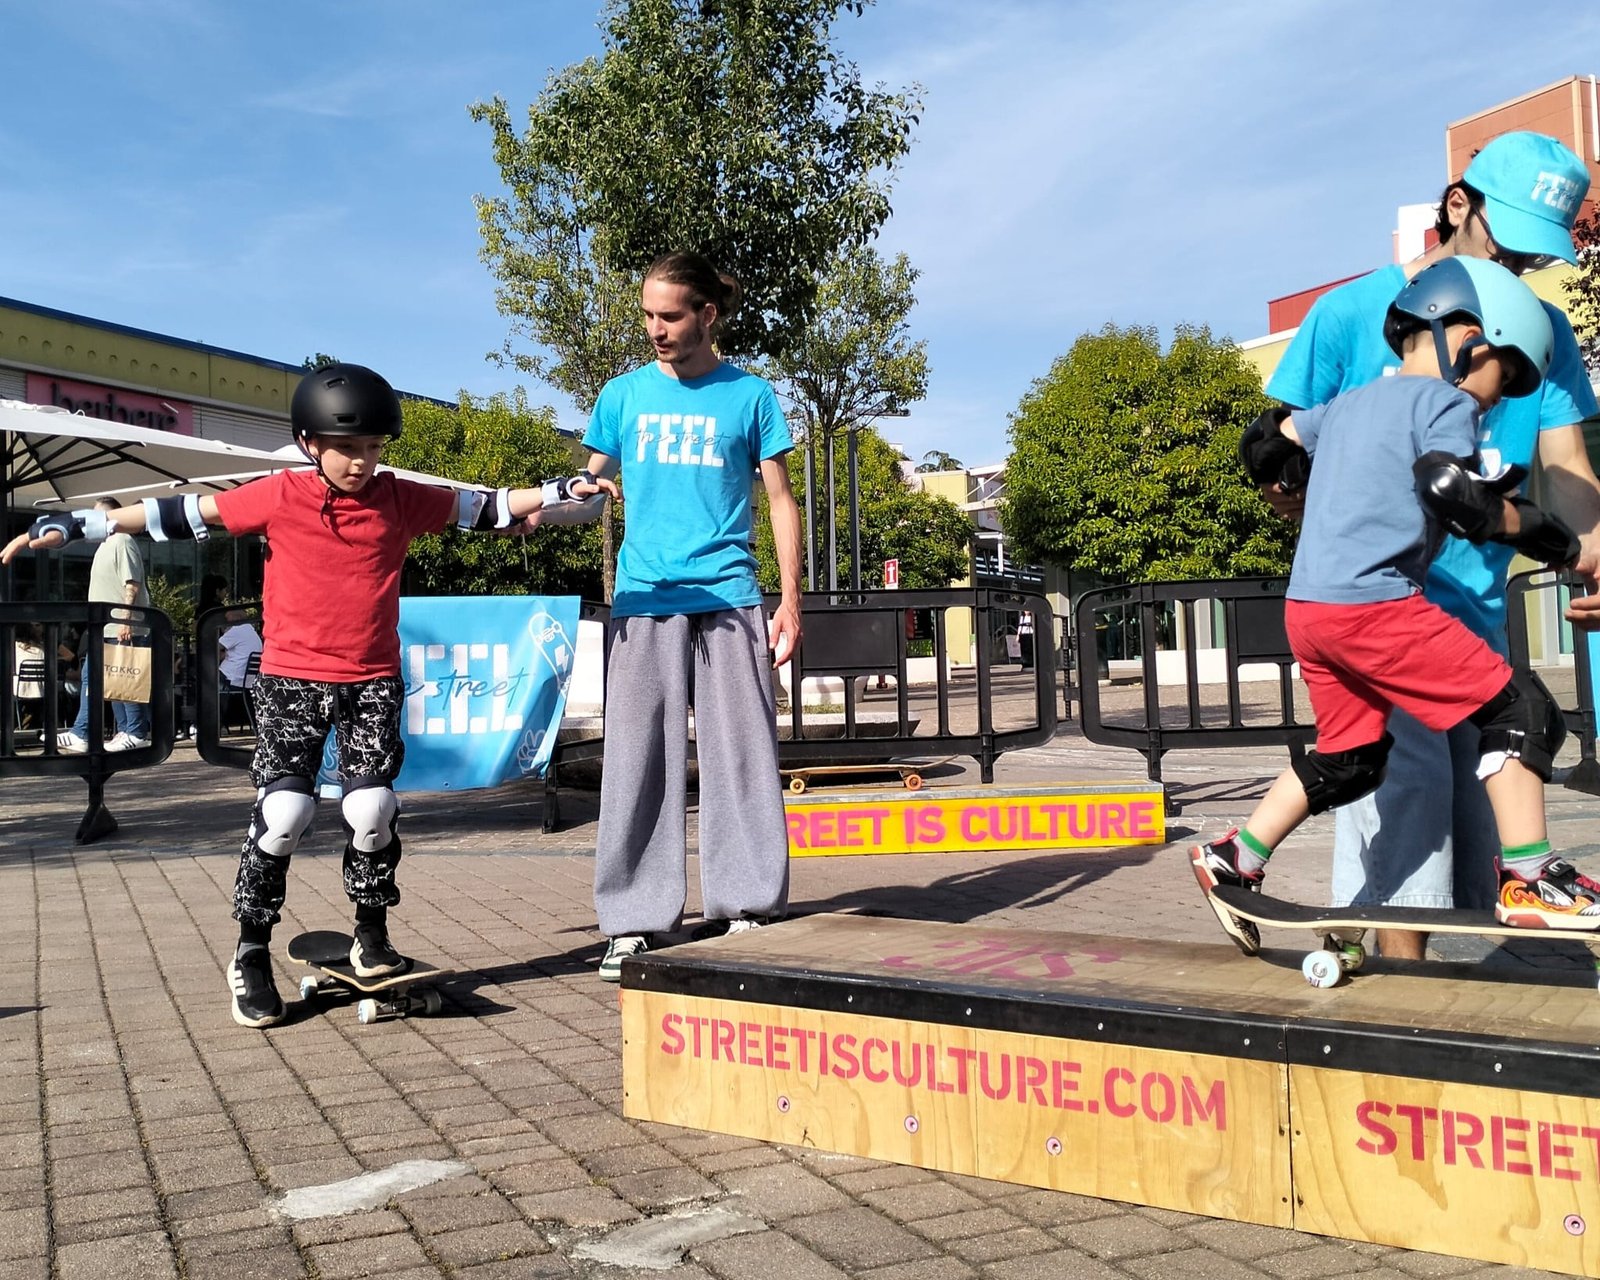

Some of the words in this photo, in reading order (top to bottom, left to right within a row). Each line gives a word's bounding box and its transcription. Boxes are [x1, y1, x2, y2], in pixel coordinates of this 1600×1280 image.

[637, 413, 724, 467] FEEL
[904, 806, 946, 844] IS
[960, 801, 1157, 843] CULTURE
[660, 1012, 1227, 1132] STREETISCULTURE.COM
